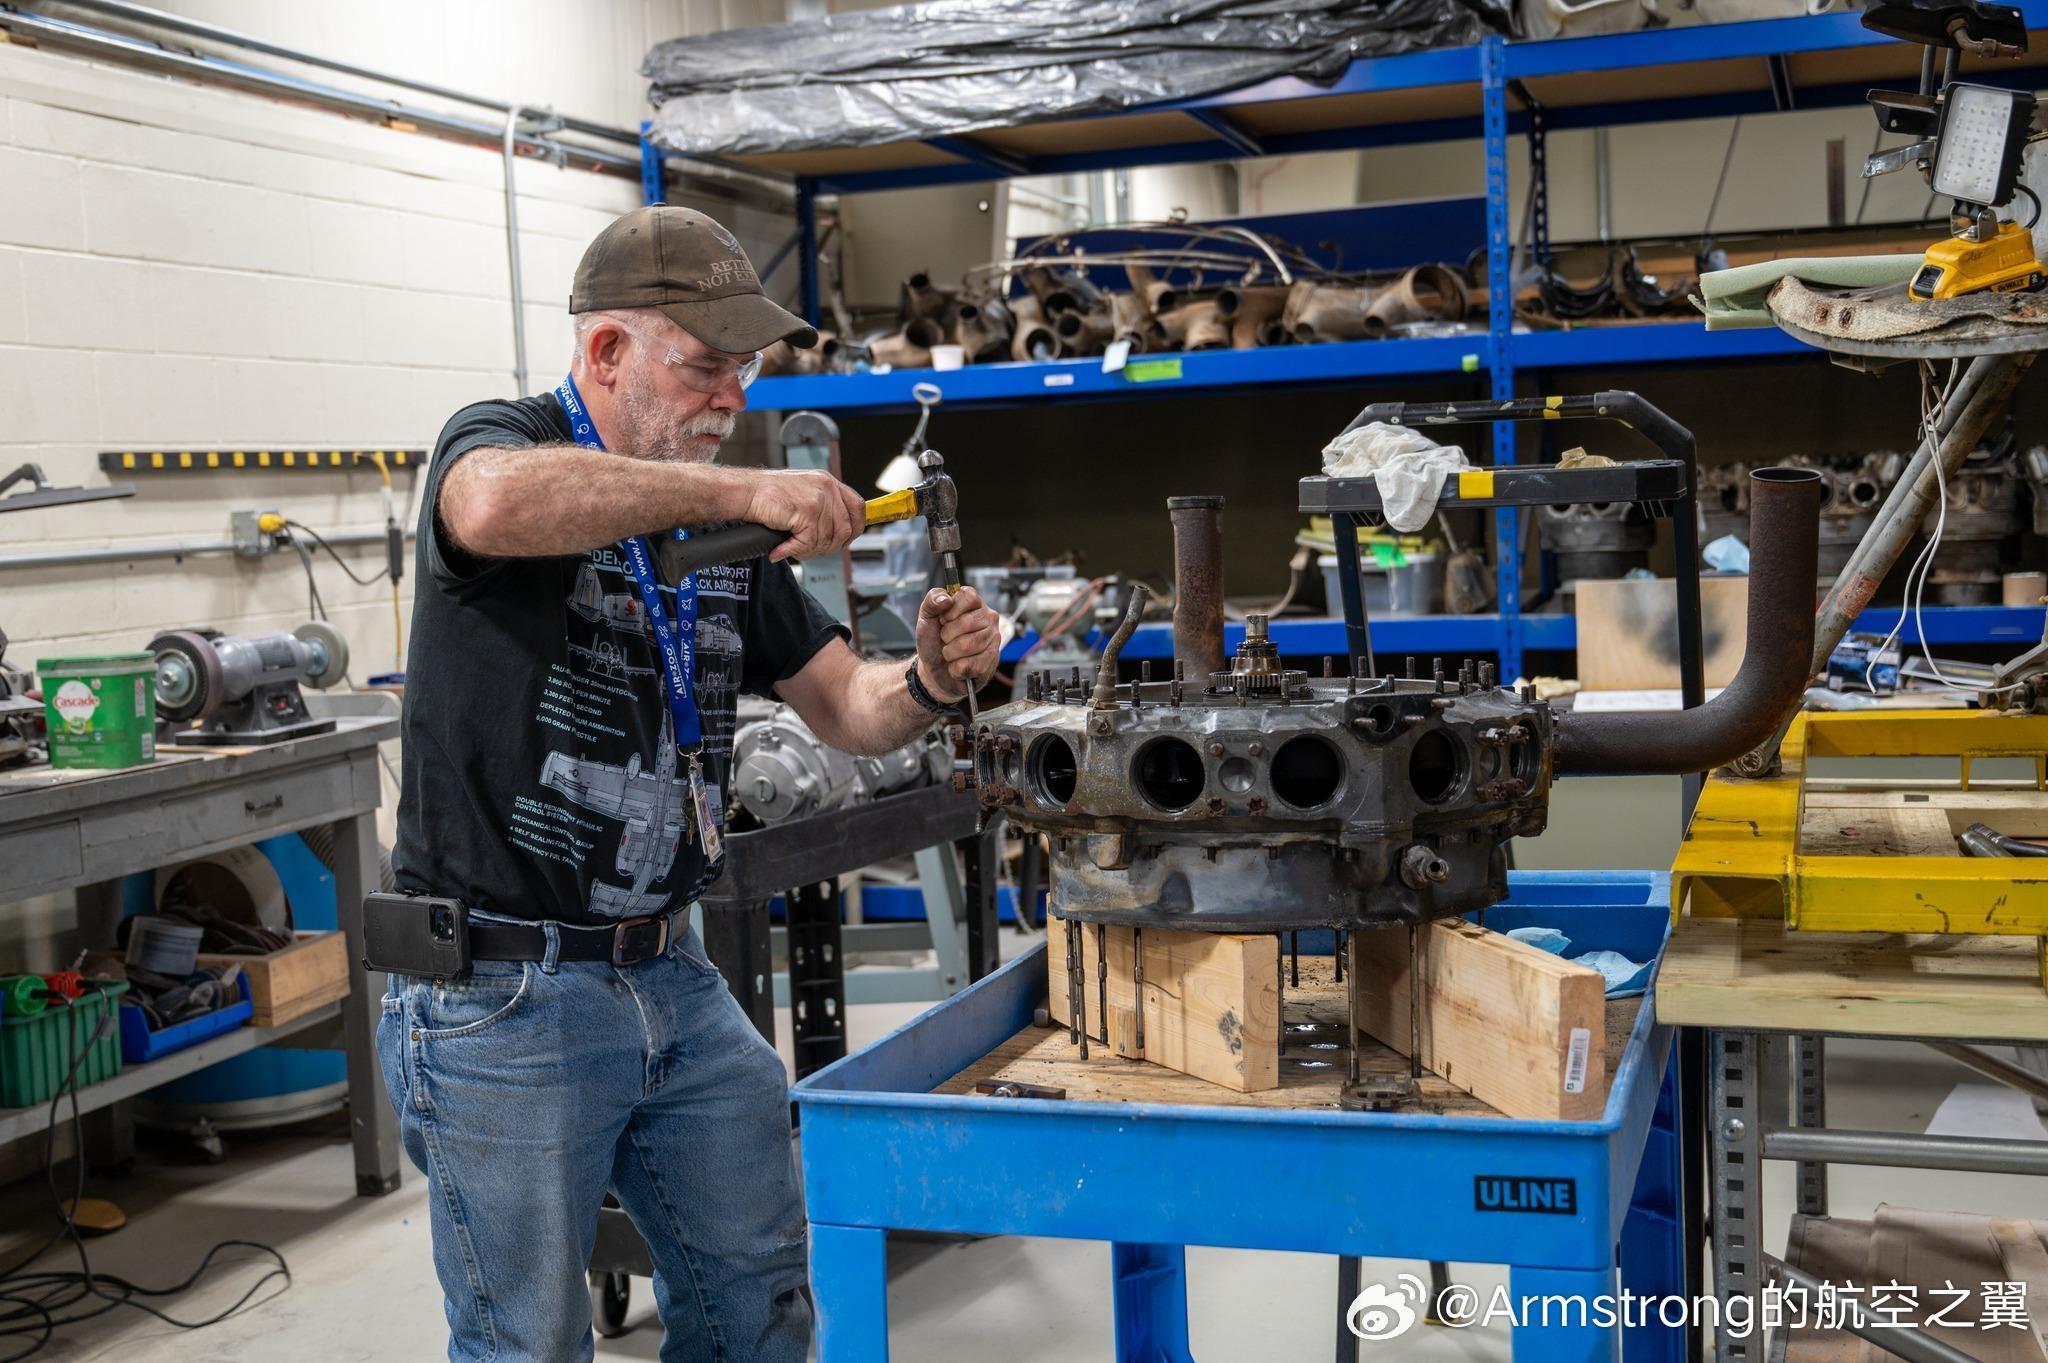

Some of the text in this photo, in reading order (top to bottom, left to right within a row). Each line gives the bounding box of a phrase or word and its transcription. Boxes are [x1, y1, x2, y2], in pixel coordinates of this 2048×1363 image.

[697, 272, 730, 291] NOT
[540, 701, 571, 718] DEPLETED
[576, 703, 603, 716] SECOND
[552, 719, 571, 732] GRAIN
[515, 795, 544, 808] DOUBLE
[514, 801, 569, 824] CONTROL SYSTEM
[511, 813, 552, 831] MECHANICAL
[551, 825, 576, 843] CONTROL
[514, 826, 530, 837] SELF
[512, 837, 549, 858] EMERGENCY
[1479, 1180, 1571, 1210] ULINE
